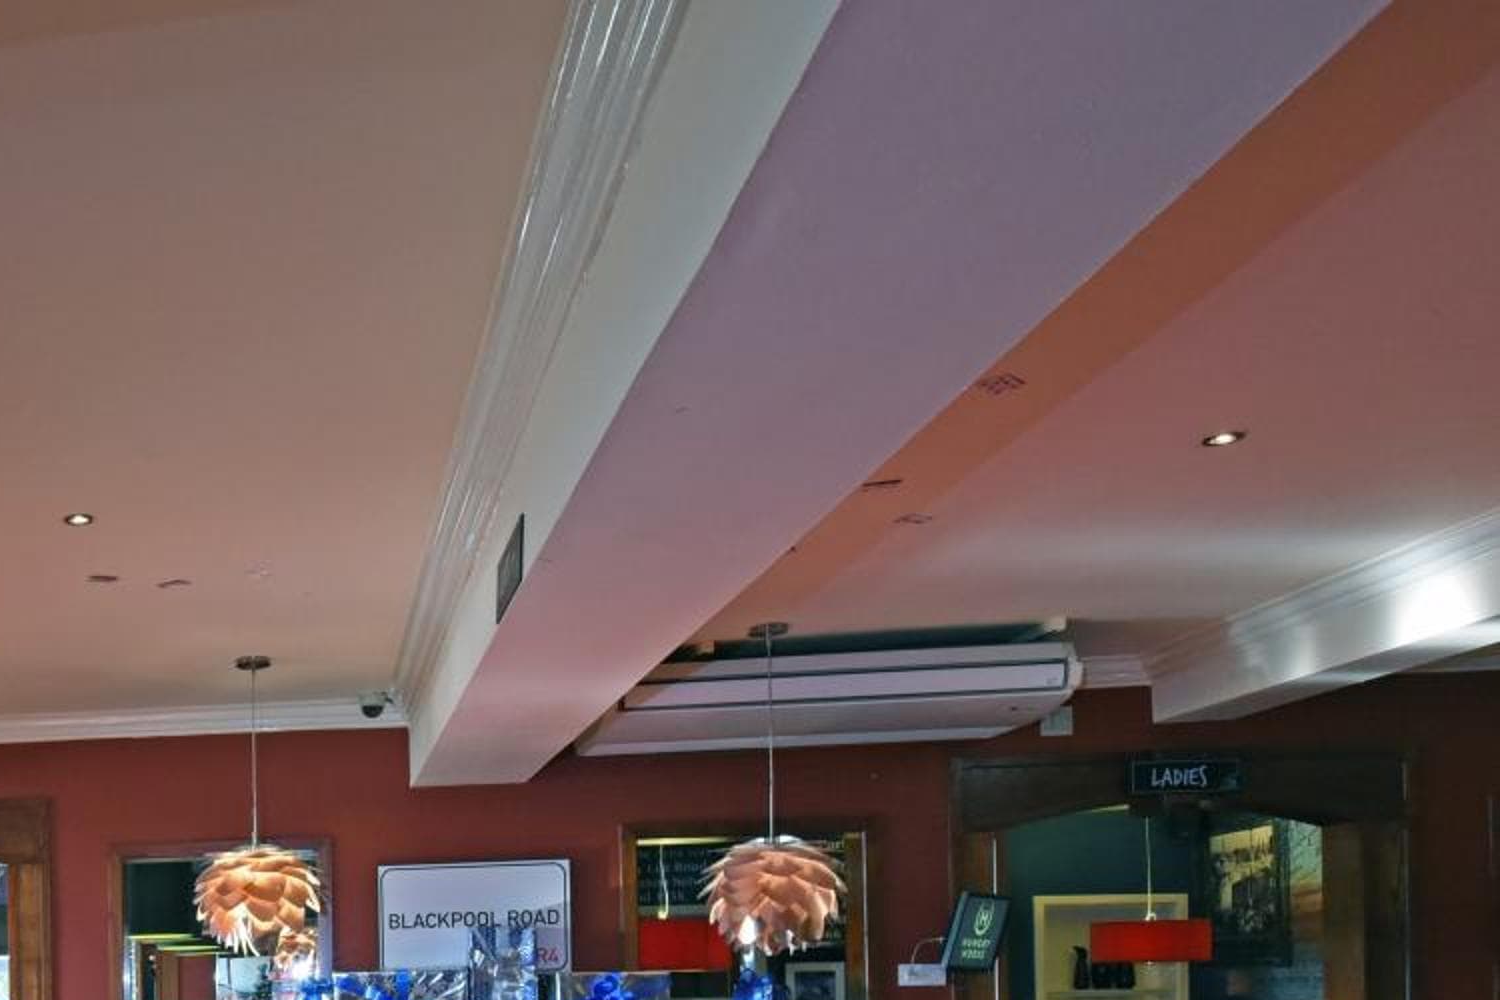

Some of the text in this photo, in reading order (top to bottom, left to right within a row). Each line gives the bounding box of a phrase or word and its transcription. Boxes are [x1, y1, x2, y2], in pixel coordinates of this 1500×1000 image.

[1151, 765, 1207, 787] LADIES
[388, 909, 560, 929] BLACKPOOL ROAD
